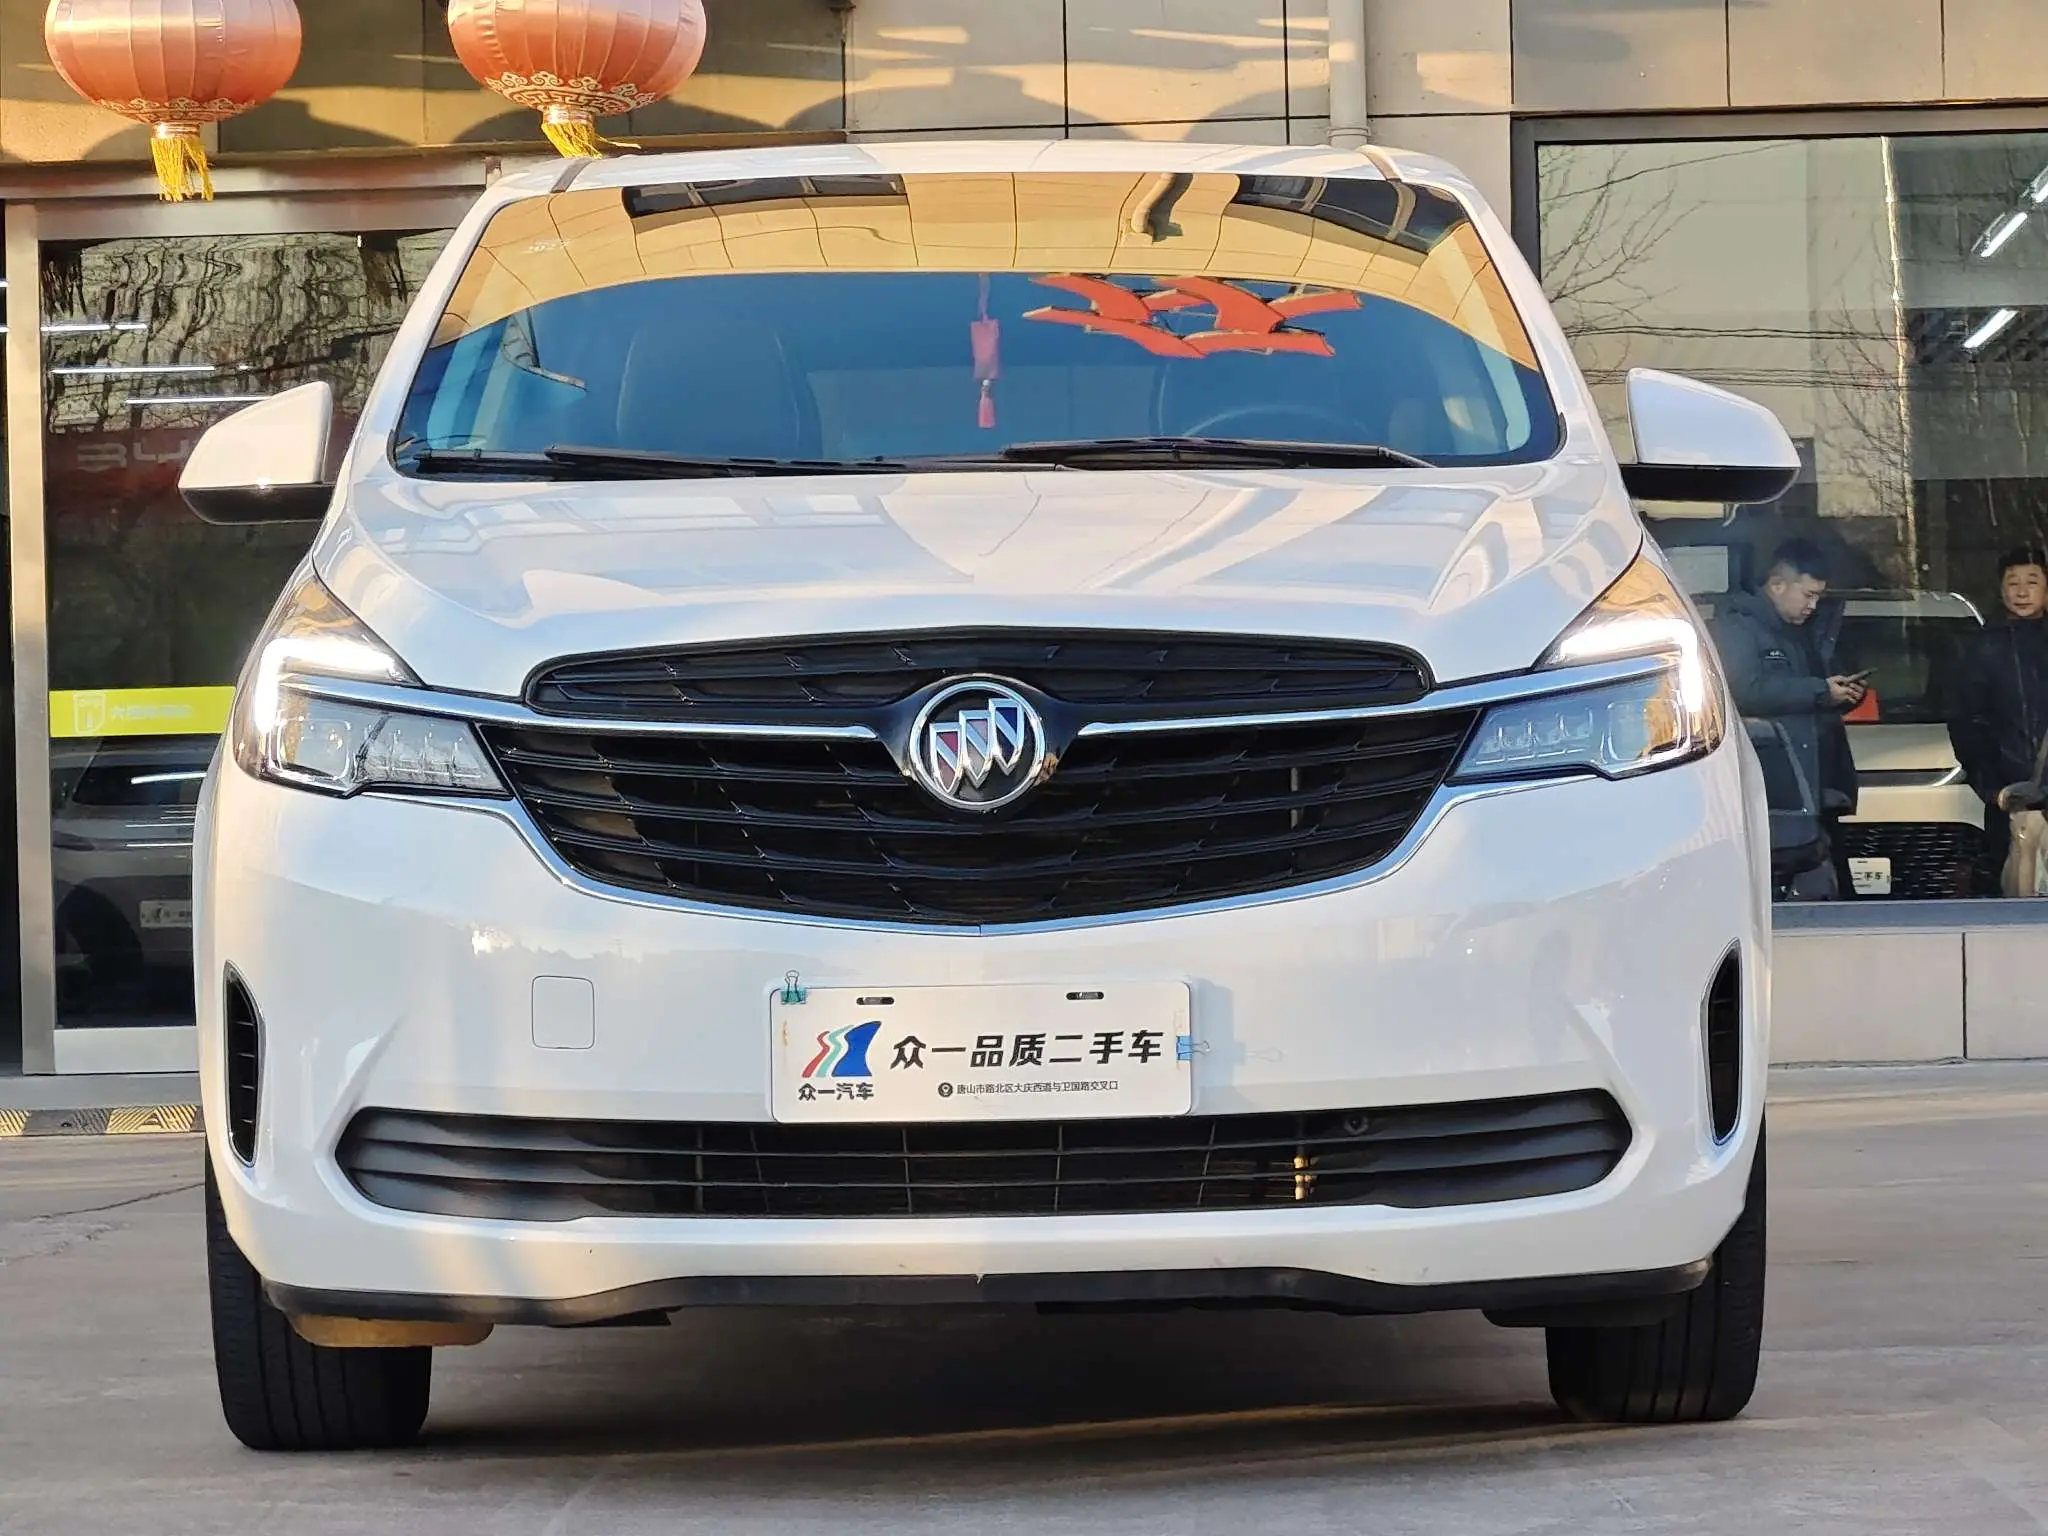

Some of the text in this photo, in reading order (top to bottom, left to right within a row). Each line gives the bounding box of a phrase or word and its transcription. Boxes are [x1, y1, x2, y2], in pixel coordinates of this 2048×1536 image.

[890, 1029, 1164, 1070] 众一品质二手车
[798, 1082, 874, 1101] 众一汽车
